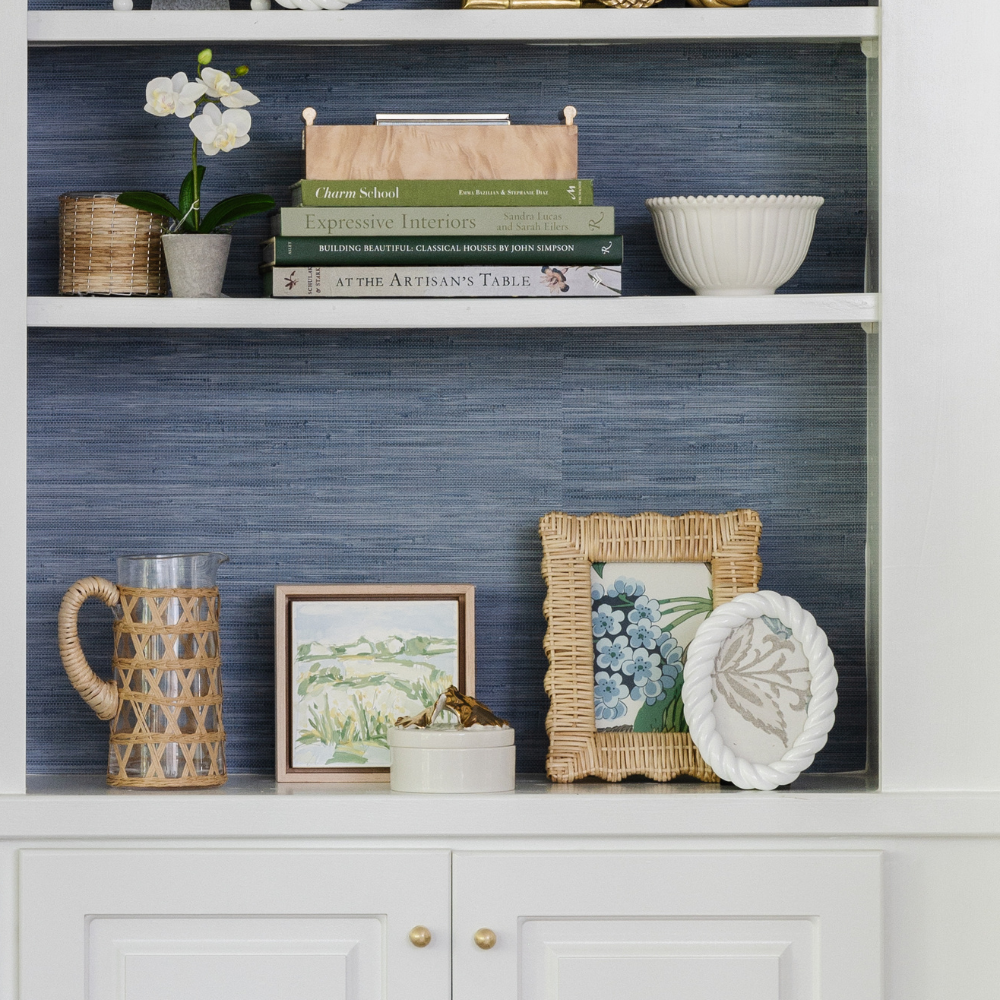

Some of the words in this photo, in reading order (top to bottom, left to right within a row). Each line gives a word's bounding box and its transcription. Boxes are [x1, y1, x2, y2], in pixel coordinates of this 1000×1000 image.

[315, 186, 356, 199] Charm
[359, 186, 399, 199] School
[503, 211, 534, 221] Sandra
[537, 212, 562, 221] Lucas
[305, 213, 394, 234] Expressive
[402, 213, 476, 229] Interiors
[496, 222, 513, 231] and
[516, 222, 541, 231] Sarah
[544, 222, 569, 231] Eilers
[319, 244, 362, 252] BUILDING
[364, 244, 413, 252] BEAUTIFUL:
[416, 244, 461, 252] CLASSICAL
[463, 244, 496, 252] HOUSES
[499, 244, 509, 252] BY
[511, 244, 535, 253] JOHN
[537, 244, 575, 252] SIMPSON
[336, 277, 353, 287] AT
[357, 277, 384, 287] THE
[479, 272, 531, 287] TABLE
